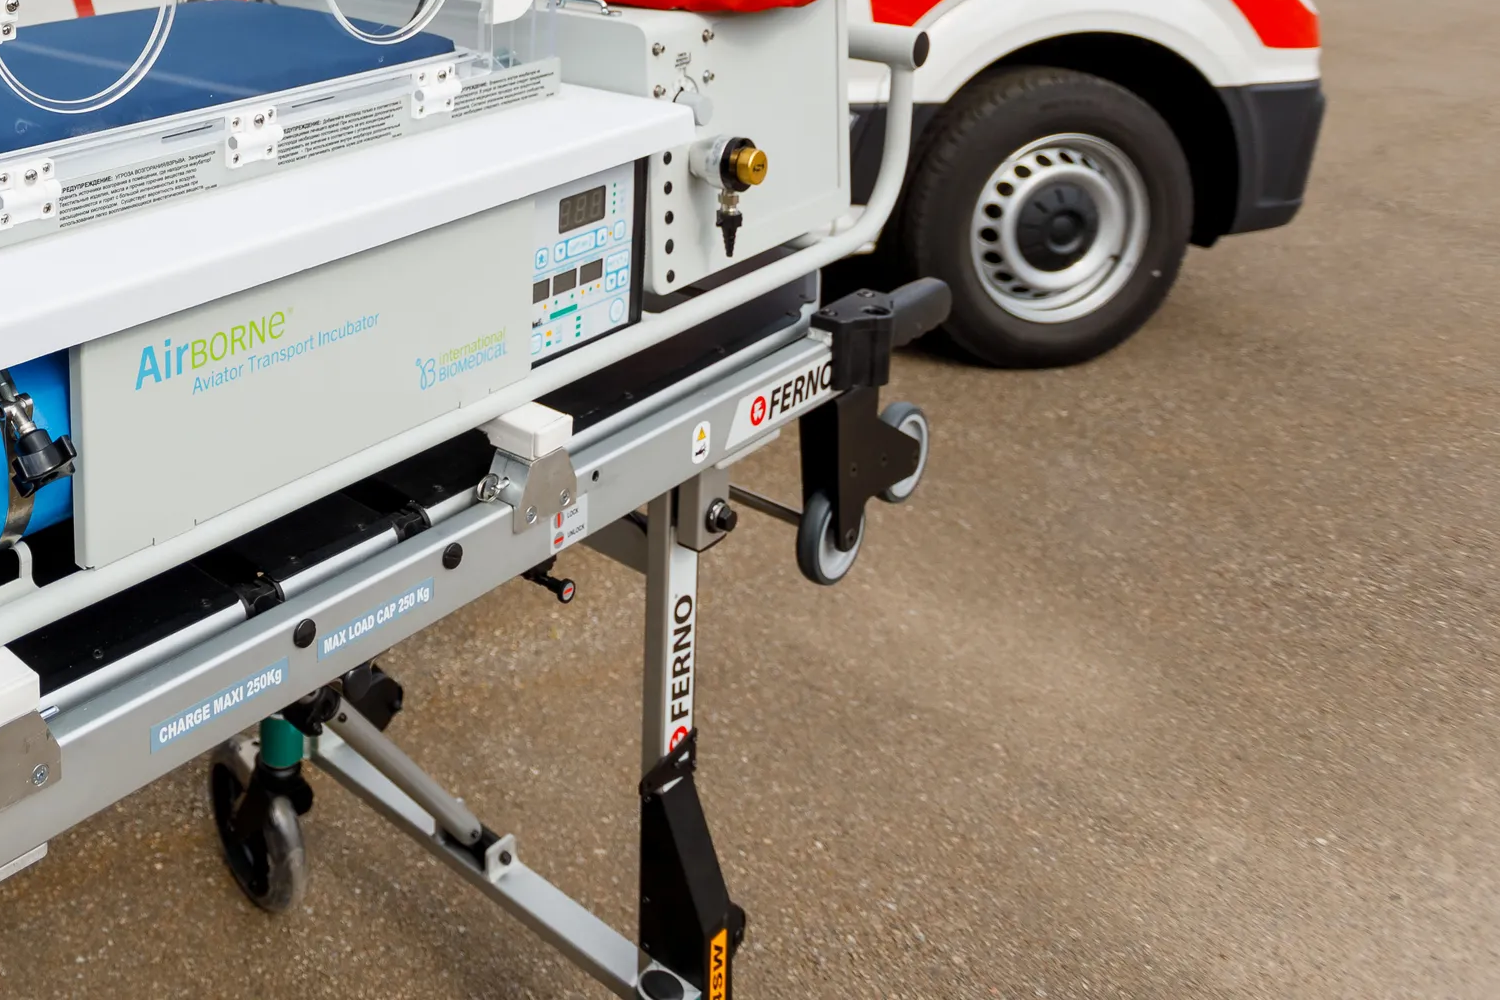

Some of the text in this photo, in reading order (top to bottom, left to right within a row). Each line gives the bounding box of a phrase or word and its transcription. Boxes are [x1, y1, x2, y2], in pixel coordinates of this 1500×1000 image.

[283, 120, 321, 134] ЕДУПРЕЖДЕНИЕ:
[192, 312, 380, 395] Aviator Transport Incubator
[439, 326, 507, 366] international
[768, 361, 833, 420] FERNO
[566, 507, 579, 519] LOCK
[567, 524, 585, 538] UNLOCK
[323, 584, 430, 654] MAX LOAD CAP 250 Kg
[670, 594, 693, 722] FERNO
[158, 667, 283, 744] CHARGE MAXI 250Kg
